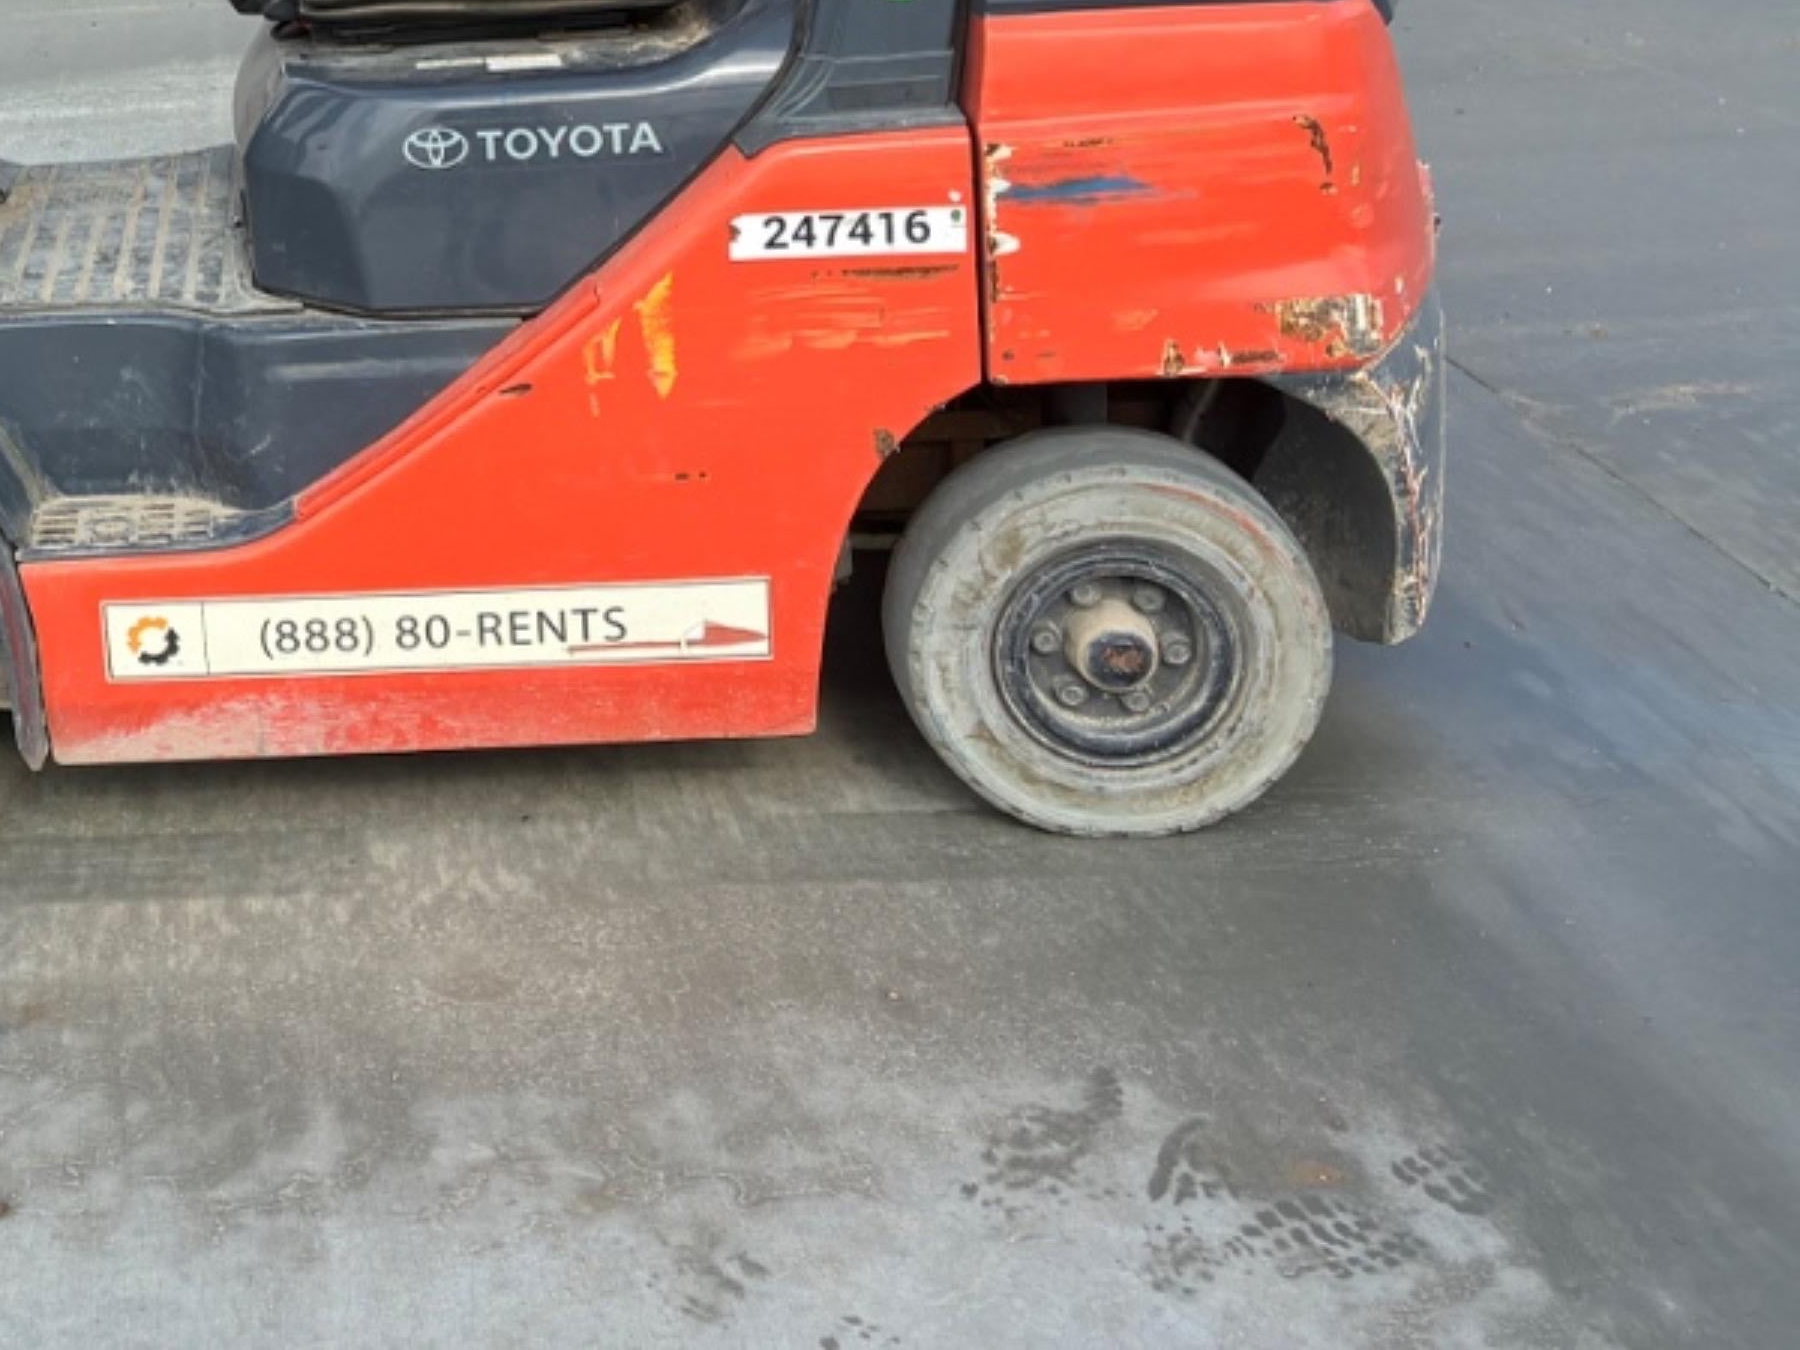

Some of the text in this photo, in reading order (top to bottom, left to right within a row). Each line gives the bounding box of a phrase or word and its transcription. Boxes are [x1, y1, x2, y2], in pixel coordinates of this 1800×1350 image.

[476, 121, 663, 161] TOYOTA
[762, 209, 932, 251] 247416
[259, 606, 628, 658] (888) 80-RENTS
